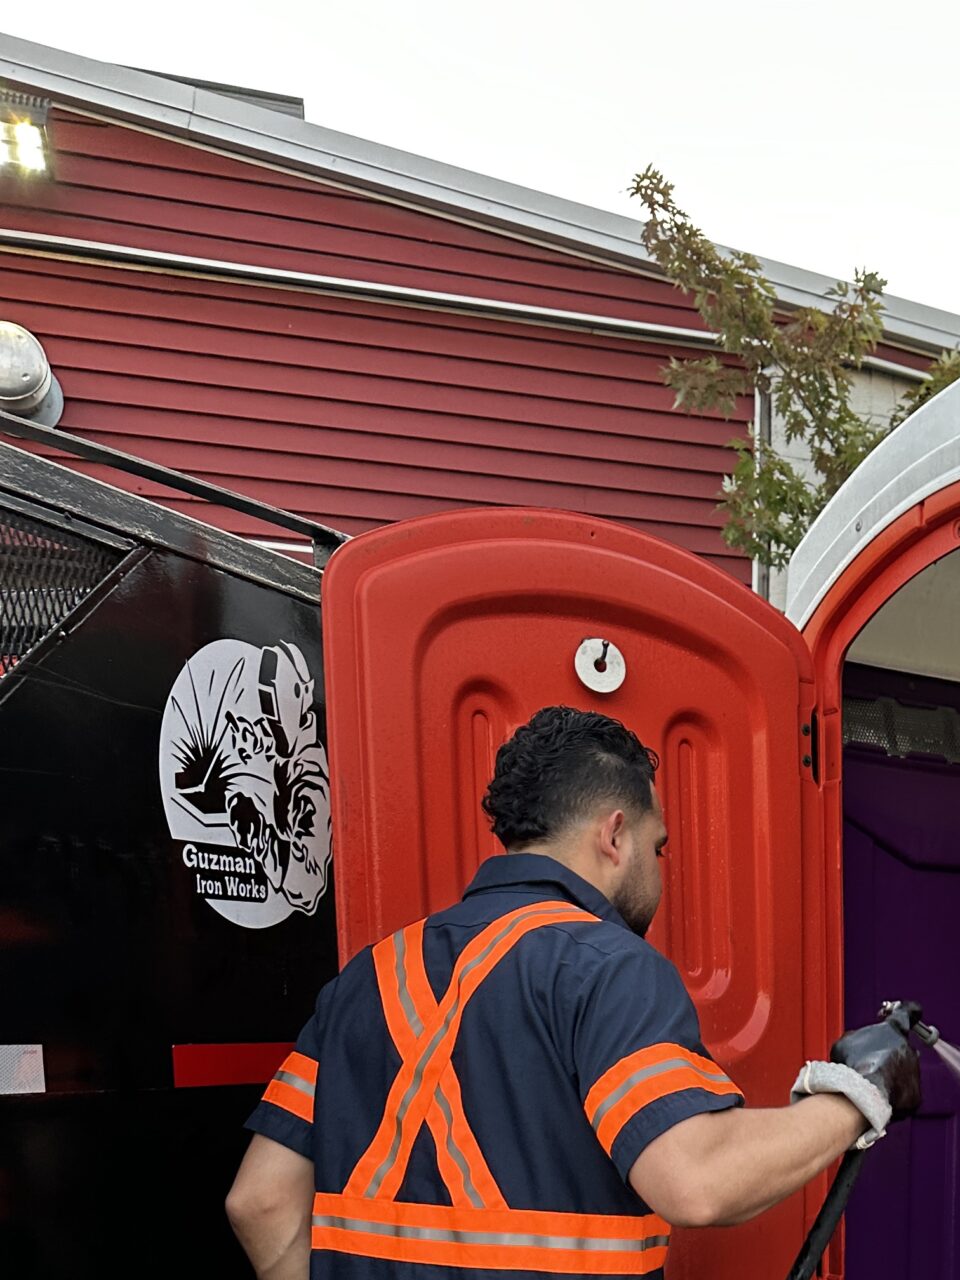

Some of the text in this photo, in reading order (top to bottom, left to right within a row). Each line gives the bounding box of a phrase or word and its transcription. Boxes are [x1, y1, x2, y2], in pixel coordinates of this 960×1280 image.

[182, 843, 256, 874] Guzman
[196, 873, 266, 899] Iron Works
